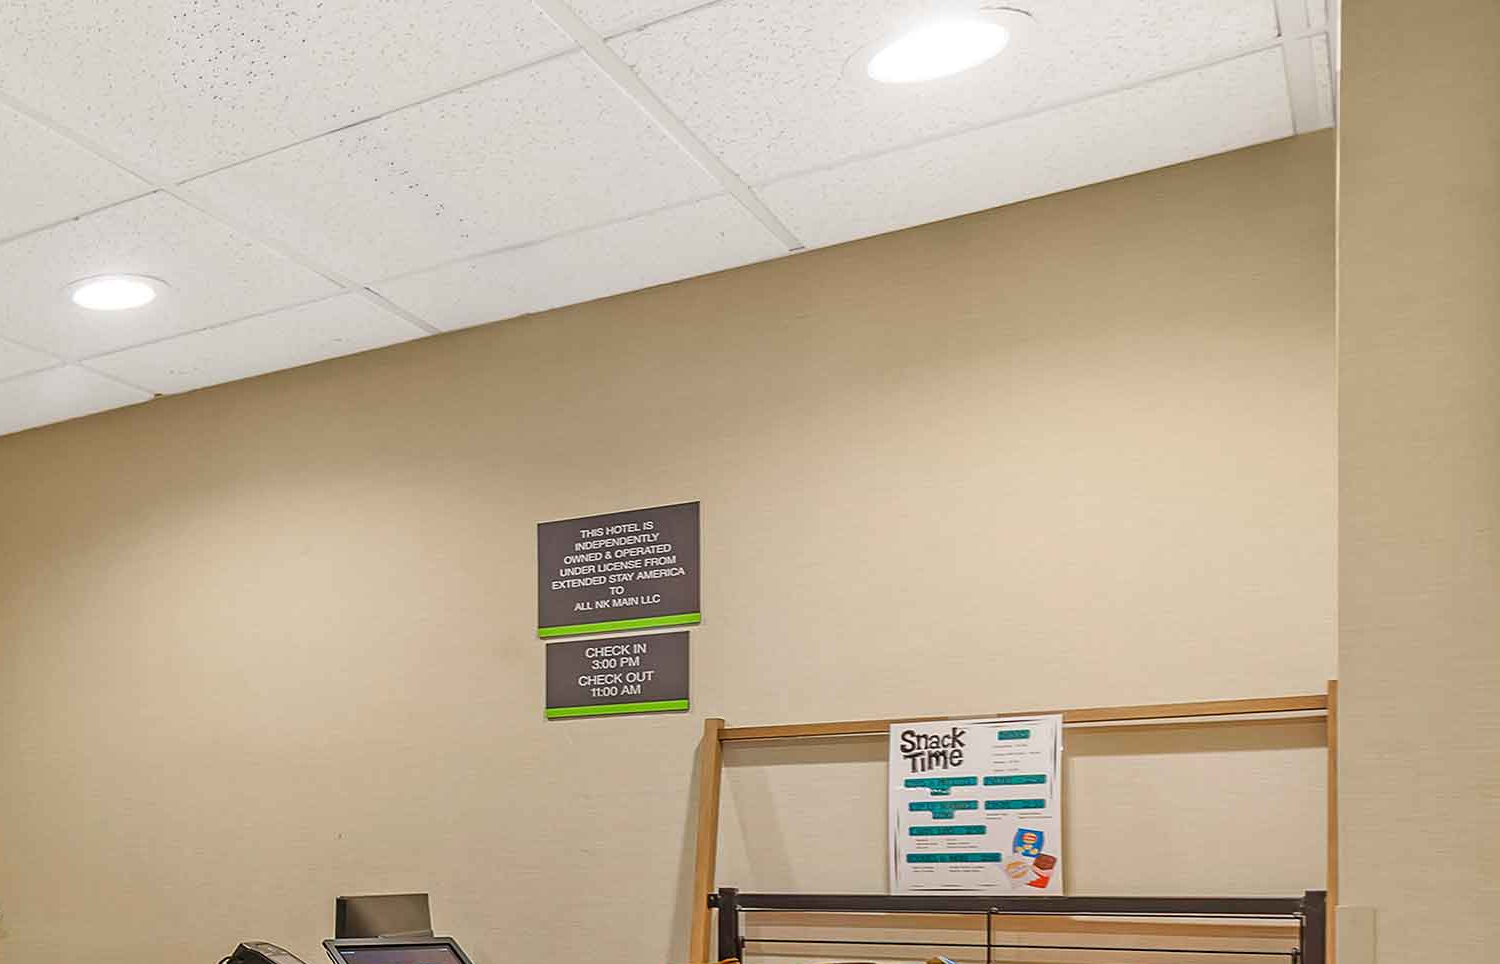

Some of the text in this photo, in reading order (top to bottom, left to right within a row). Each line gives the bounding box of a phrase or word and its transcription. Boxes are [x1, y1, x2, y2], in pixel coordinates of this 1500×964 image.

[580, 521, 654, 539] THIS HOTEL IS
[575, 532, 660, 552] INDEPENDENTLY
[563, 543, 672, 565] OWNED & OPERATED
[560, 555, 677, 577] UNDER LICENSE FROM
[551, 566, 686, 590] EXTENDED STAY AMERICA
[609, 585, 625, 596] TO
[574, 594, 661, 612] ALL NK MAIN LLC
[585, 643, 647, 659] CHECK IN
[591, 656, 640, 670] 3:00 PM
[578, 670, 655, 687] CHECK OUT
[590, 684, 642, 697] 11:00 AM
[900, 727, 967, 753] Snack
